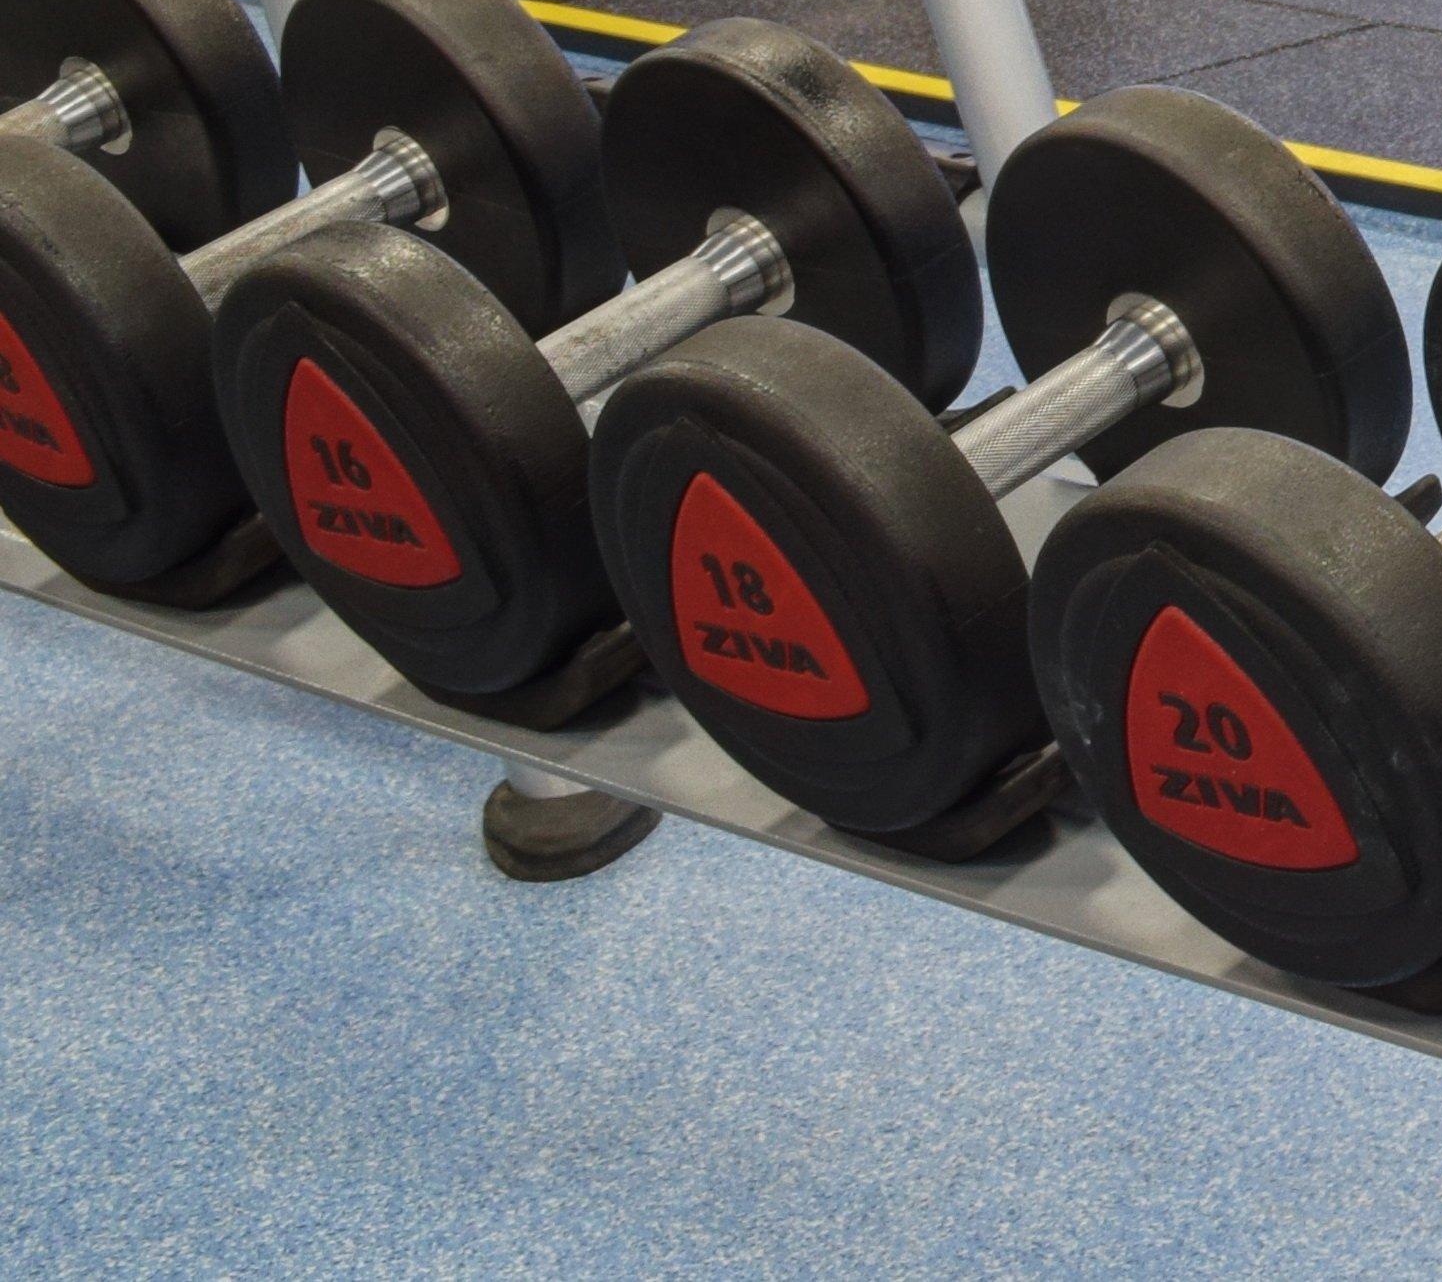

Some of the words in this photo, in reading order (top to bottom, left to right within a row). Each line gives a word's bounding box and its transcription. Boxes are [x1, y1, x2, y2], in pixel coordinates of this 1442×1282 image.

[310, 435, 372, 491] 16
[307, 500, 425, 549] ZIVA
[702, 553, 775, 616] 18
[694, 621, 830, 681] ZIVA
[1158, 691, 1253, 761] 20
[1151, 764, 1312, 829] ZIVA
